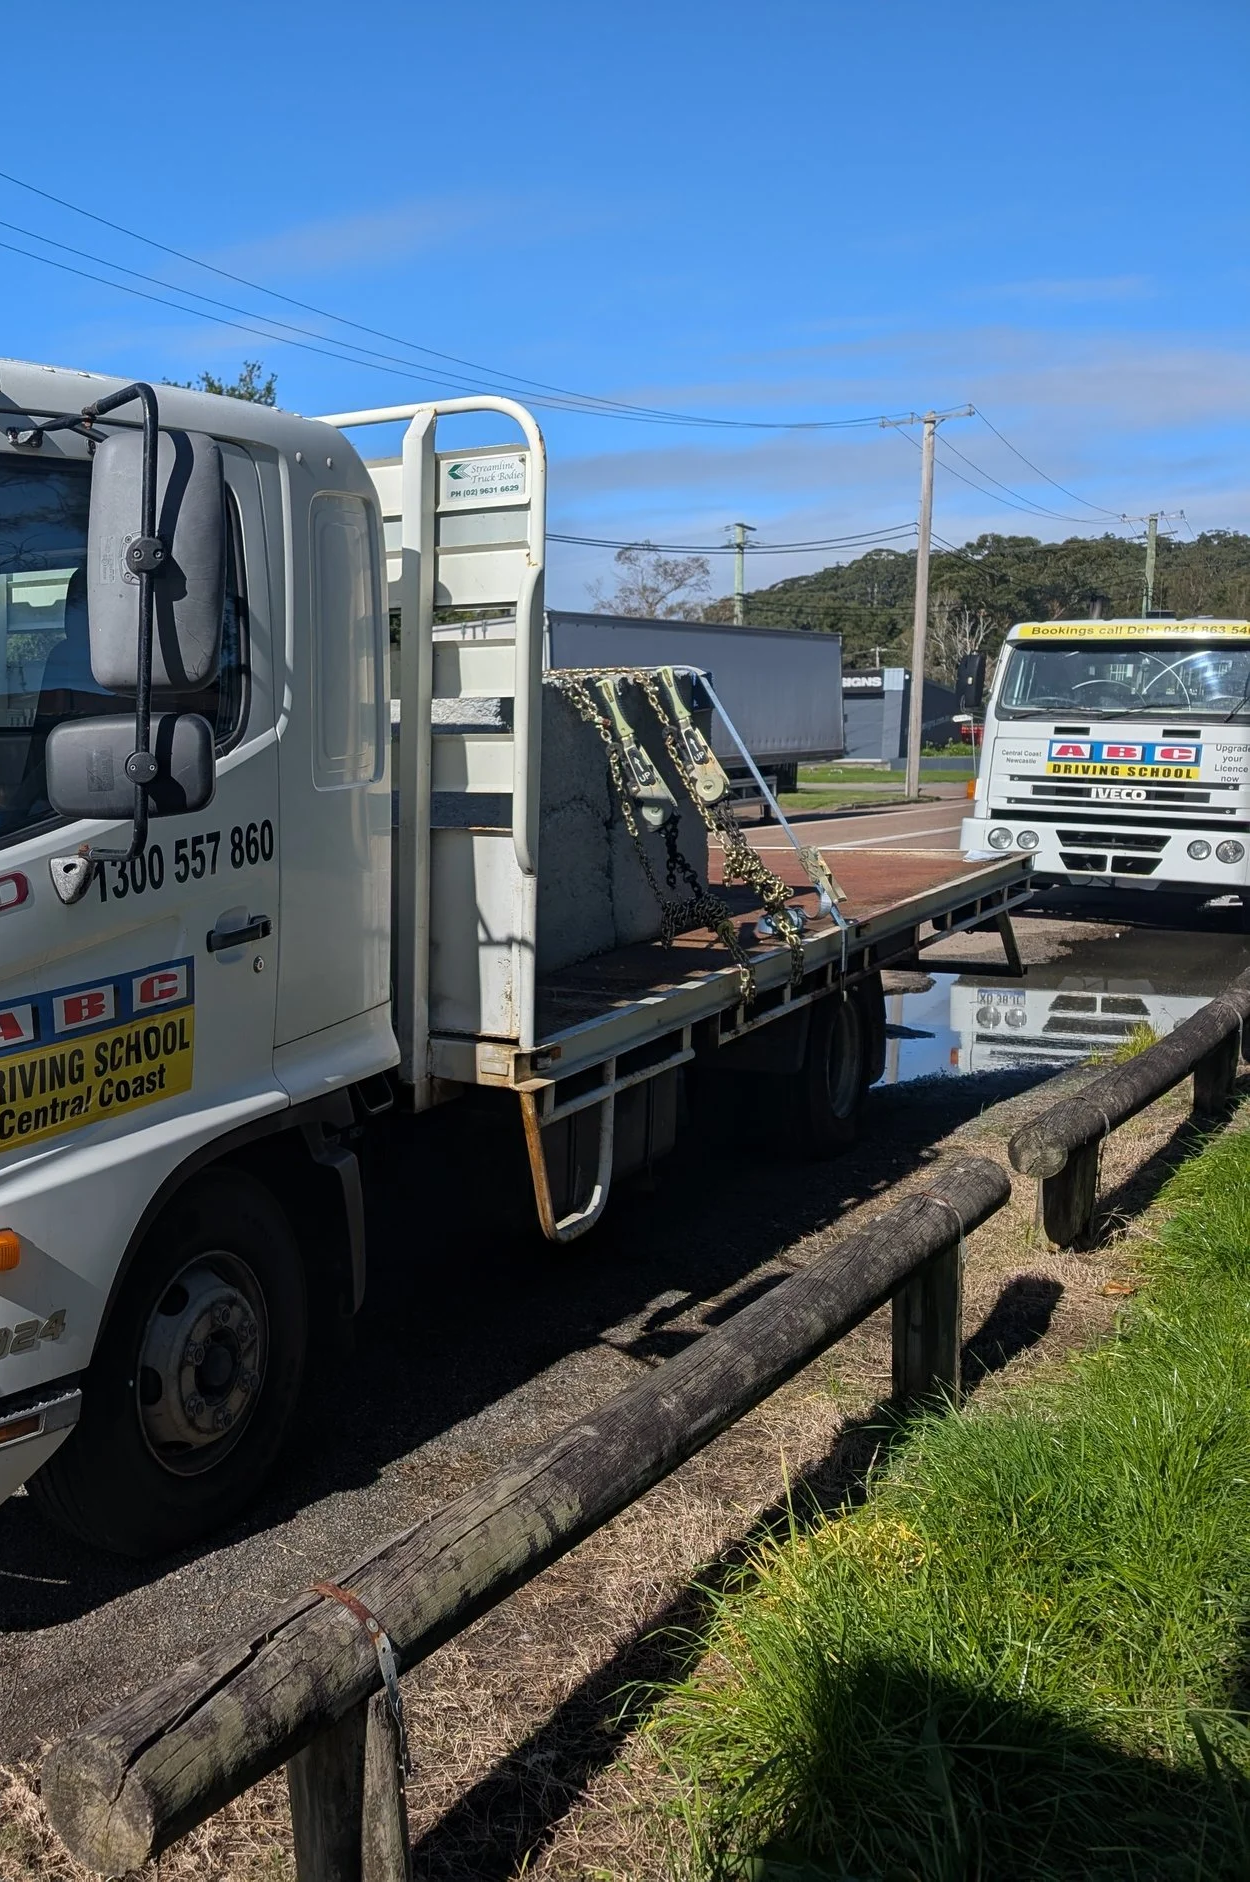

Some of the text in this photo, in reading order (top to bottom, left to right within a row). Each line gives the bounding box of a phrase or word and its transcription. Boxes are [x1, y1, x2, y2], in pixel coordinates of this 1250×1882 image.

[471, 460, 514, 473] Streamline
[471, 469, 524, 483] Truck Bodies
[464, 489, 478, 497] (02)
[480, 487, 497, 495] 9631
[501, 484, 519, 492] 6629
[1031, 626, 1094, 635] Bookings
[1100, 625, 1122, 635] call
[694, 751, 705, 761] UP
[1002, 749, 1026, 757] Central
[1006, 757, 1037, 765] Newcastle
[1222, 756, 1243, 764] your
[1052, 763, 1193, 778] DRIVING SCHOOL
[1215, 764, 1249, 773] Licence
[638, 772, 650, 782] UP
[1091, 788, 1147, 800] IVECO
[93, 819, 274, 903] 1300 557 860
[94, 1017, 190, 1078] SCHOOL
[100, 1063, 166, 1108] Coast
